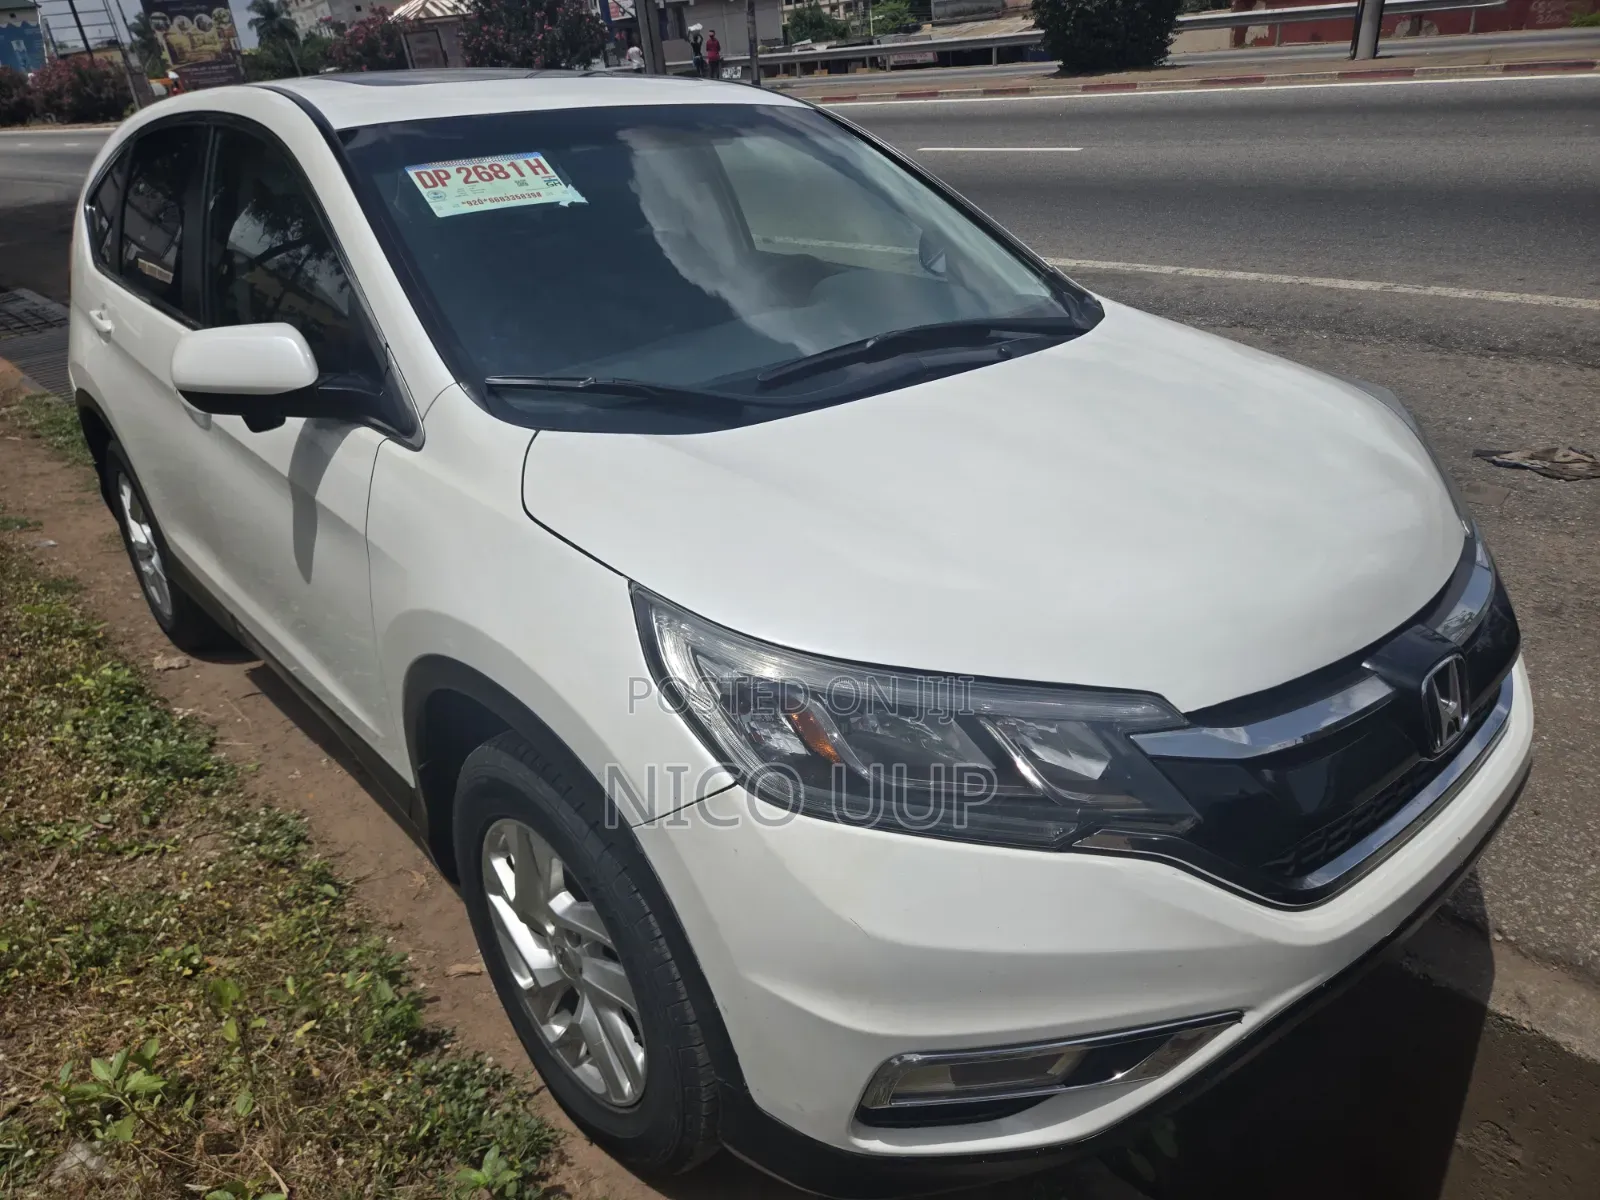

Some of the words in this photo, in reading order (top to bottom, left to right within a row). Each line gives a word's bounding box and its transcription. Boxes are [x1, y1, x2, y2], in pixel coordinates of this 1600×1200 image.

[414, 169, 451, 189] DP
[456, 162, 526, 184] 2681
[525, 158, 550, 175] H
